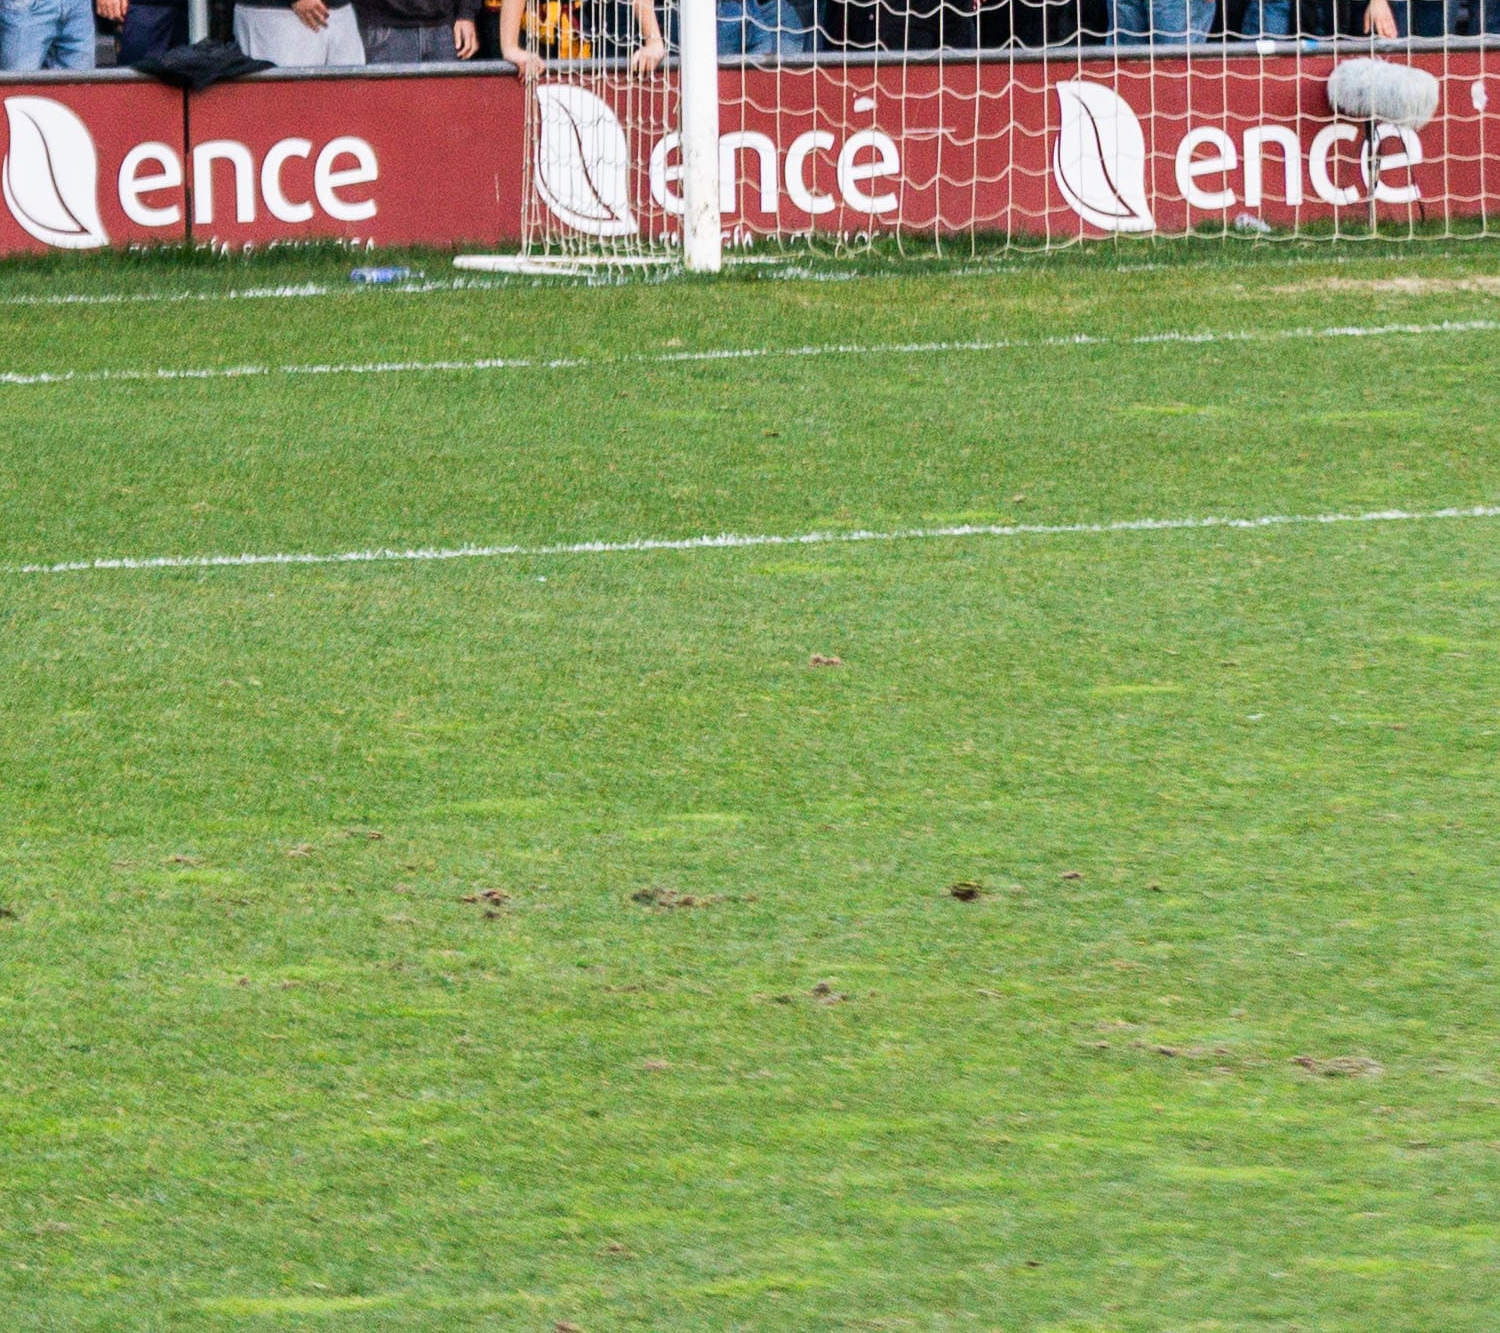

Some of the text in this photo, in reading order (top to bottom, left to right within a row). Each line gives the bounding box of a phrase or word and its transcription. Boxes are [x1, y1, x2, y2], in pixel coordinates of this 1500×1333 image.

[118, 135, 380, 228] ence
[649, 127, 902, 215] ence
[1175, 122, 1424, 211] ence
